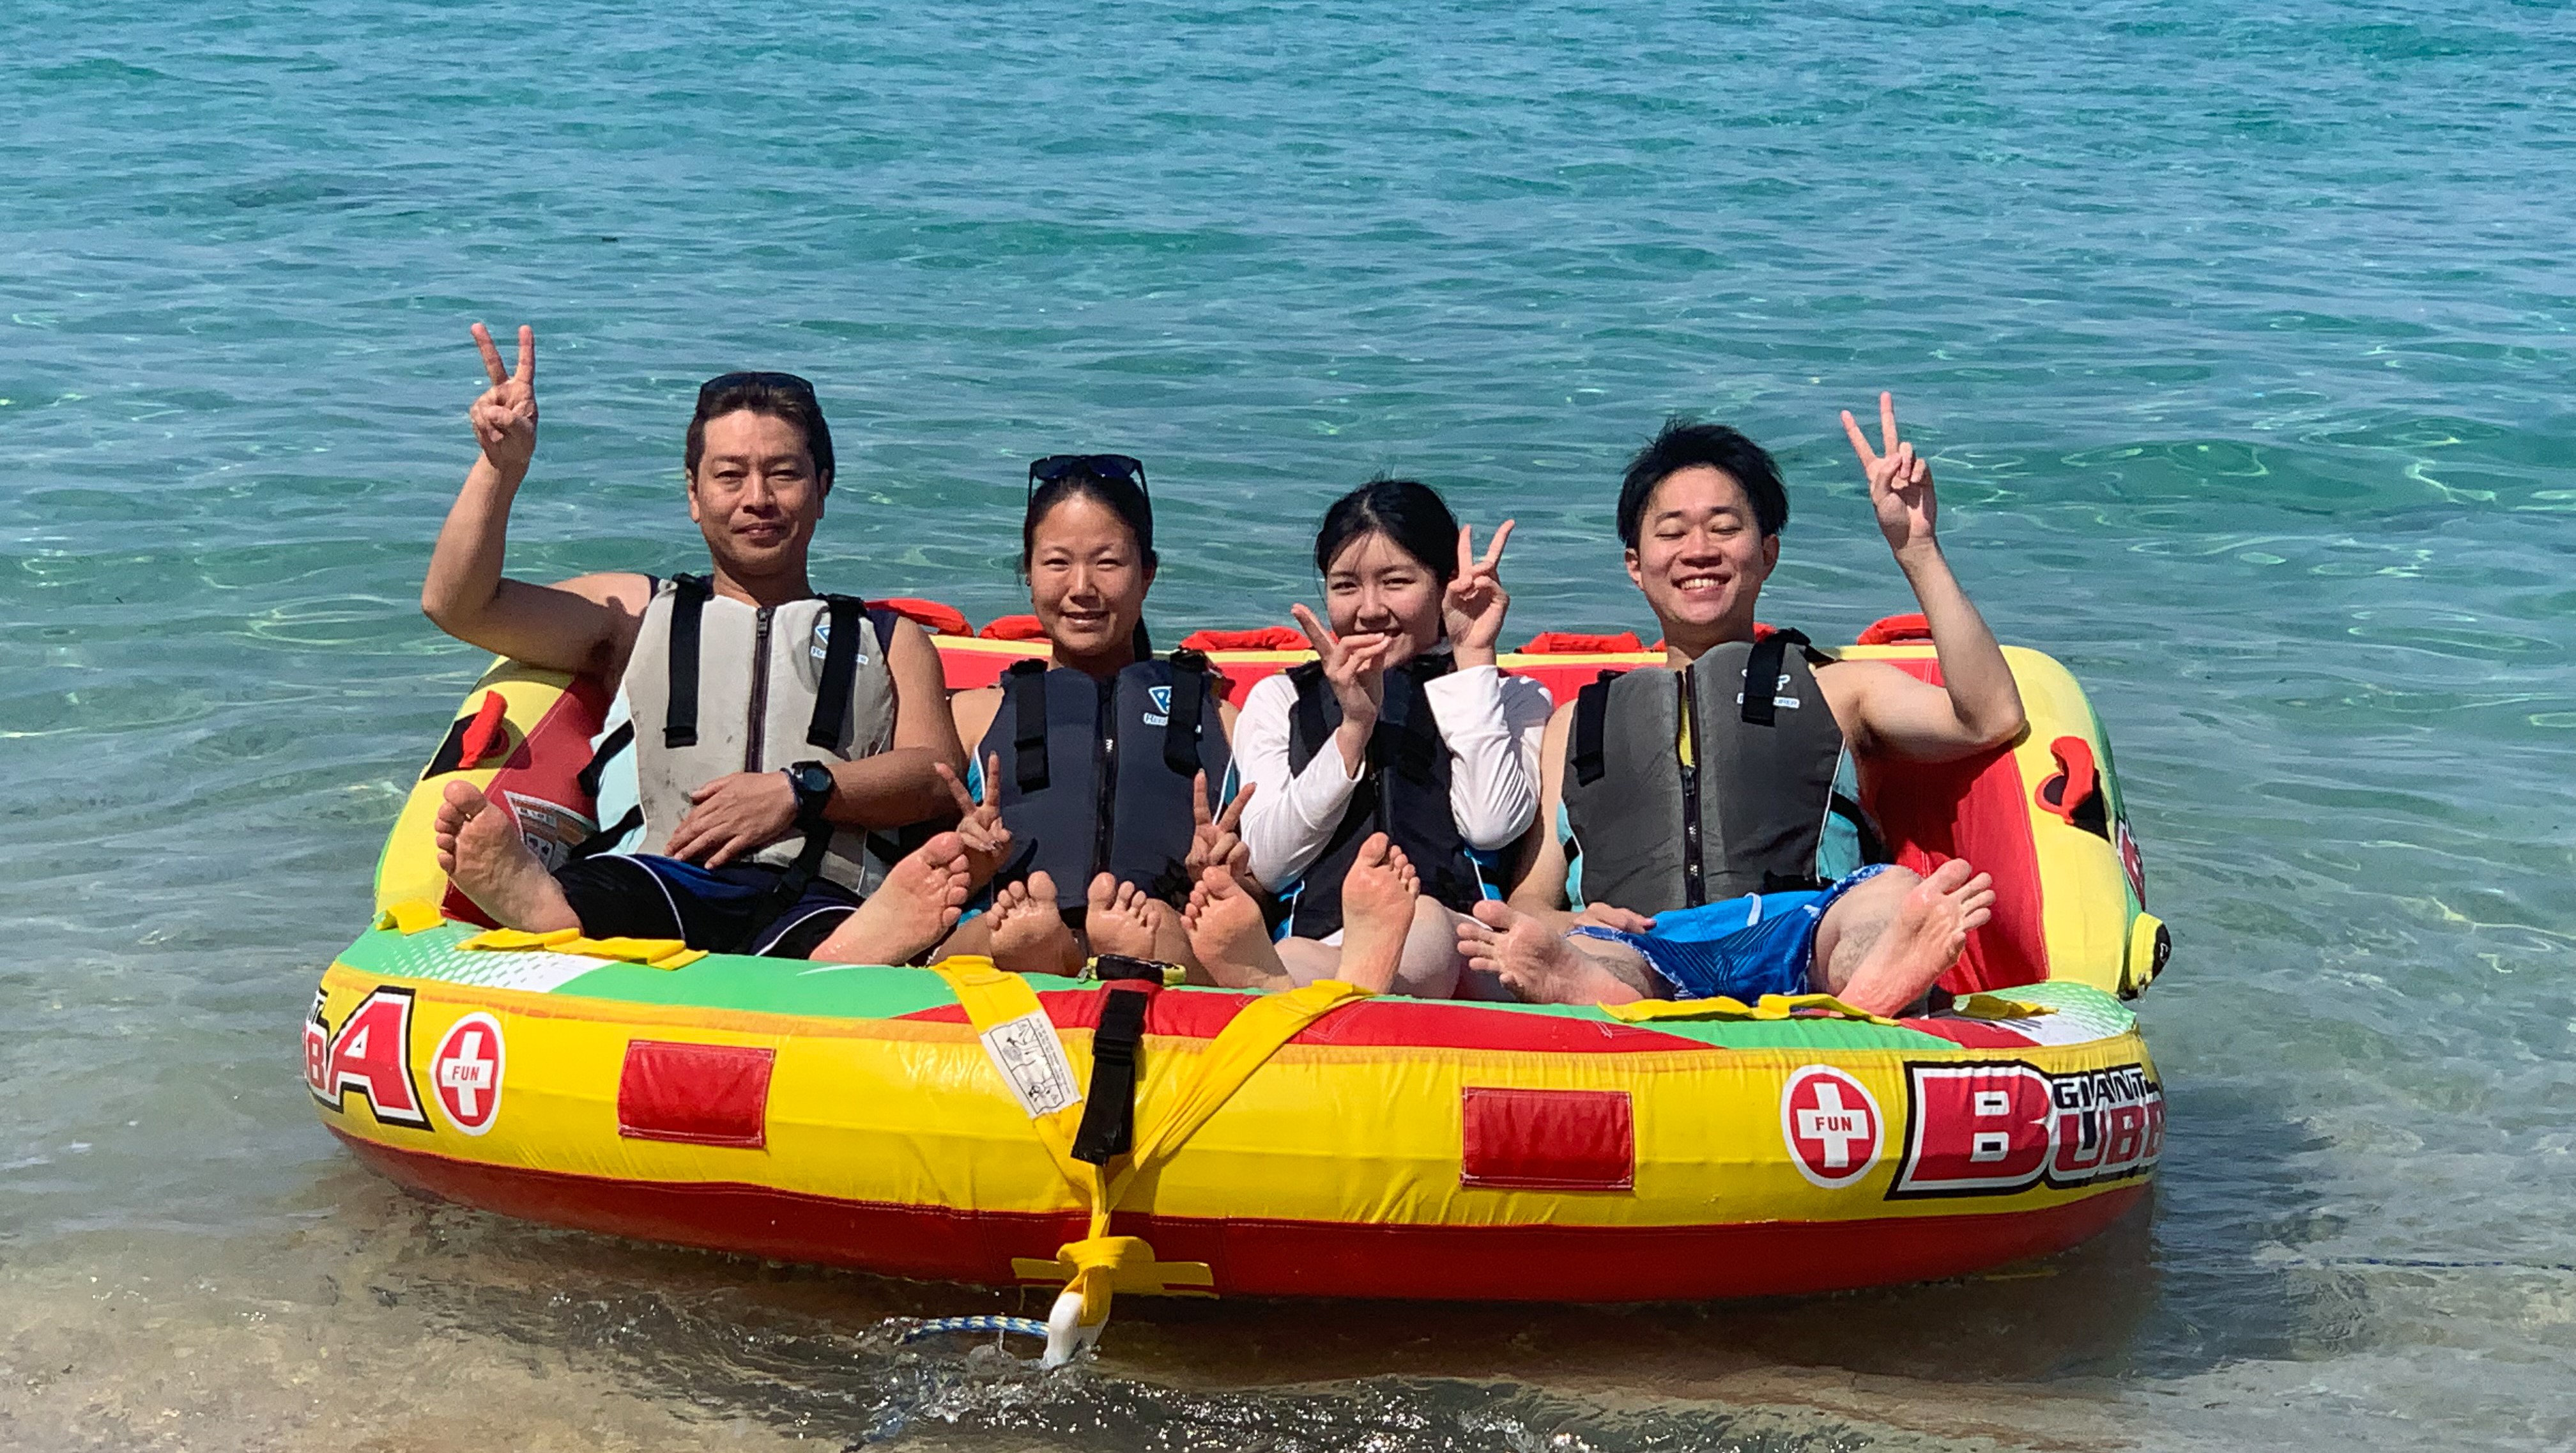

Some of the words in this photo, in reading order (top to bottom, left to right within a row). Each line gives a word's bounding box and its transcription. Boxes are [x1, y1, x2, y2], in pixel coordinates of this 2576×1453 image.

[452, 1065, 480, 1081] FUN
[2052, 1072, 2147, 1109] GIANT
[1815, 1116, 1853, 1133] FUN
